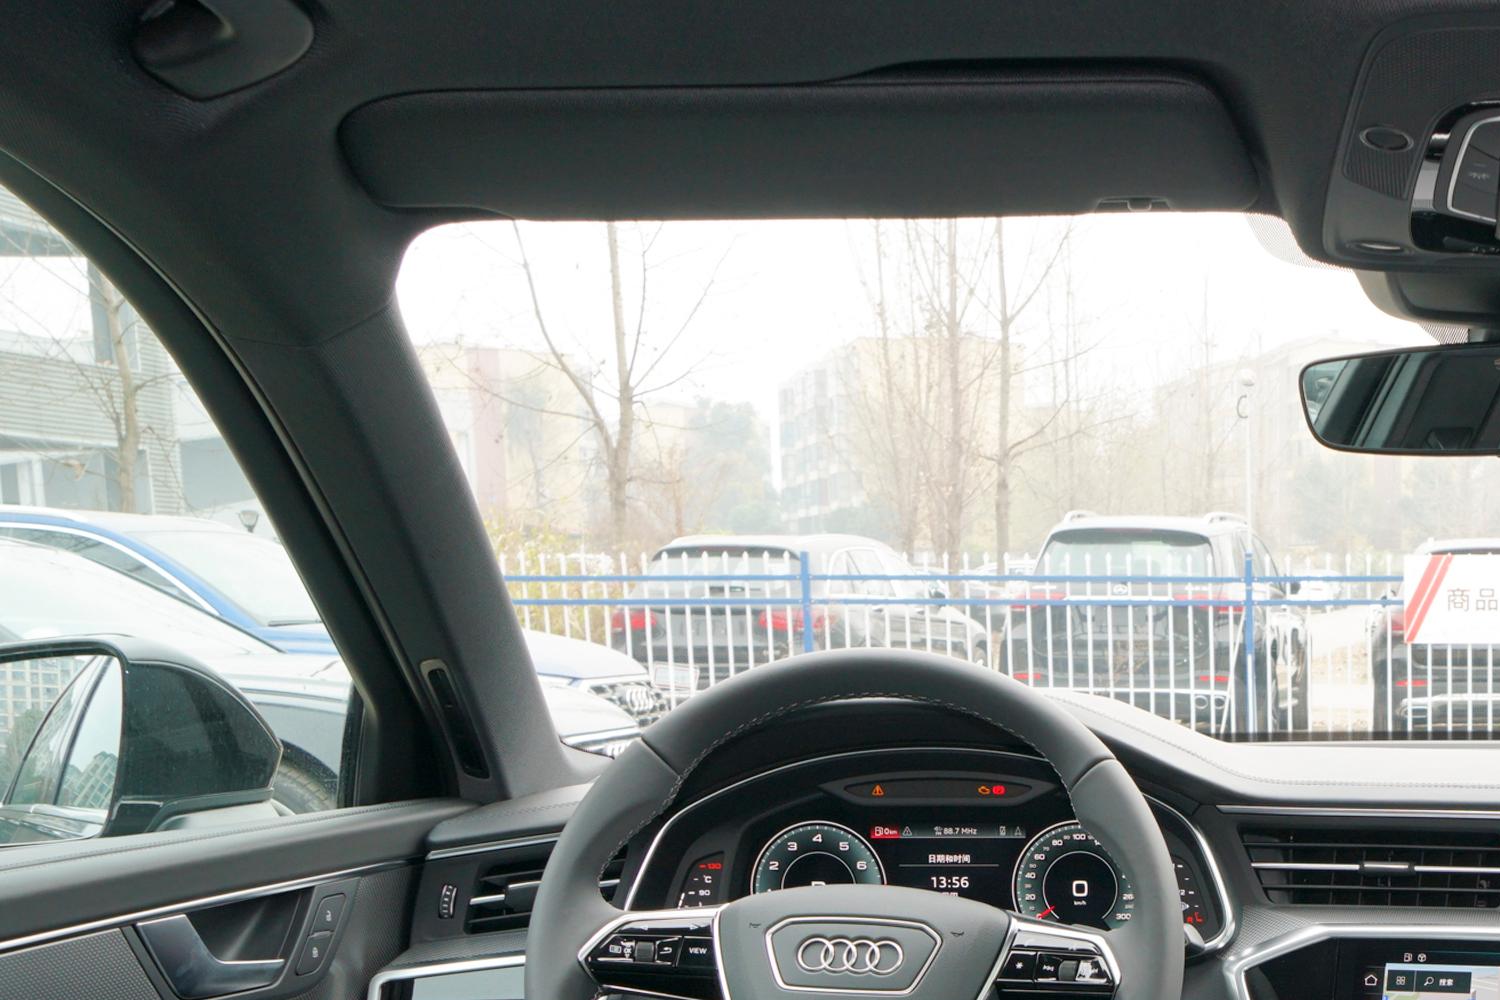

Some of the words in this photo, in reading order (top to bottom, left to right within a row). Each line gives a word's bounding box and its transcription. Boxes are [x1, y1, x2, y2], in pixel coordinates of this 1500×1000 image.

[943, 827, 959, 835] 88.7
[961, 827, 977, 835] MHz
[812, 833, 822, 843] 4
[788, 842, 797, 851] 3
[840, 842, 849, 851] 5
[928, 854, 971, 864] 日期和时间
[769, 861, 779, 870] 2
[857, 861, 867, 870] 6
[931, 876, 969, 888] 13:56
[1072, 880, 1088, 897] 0
